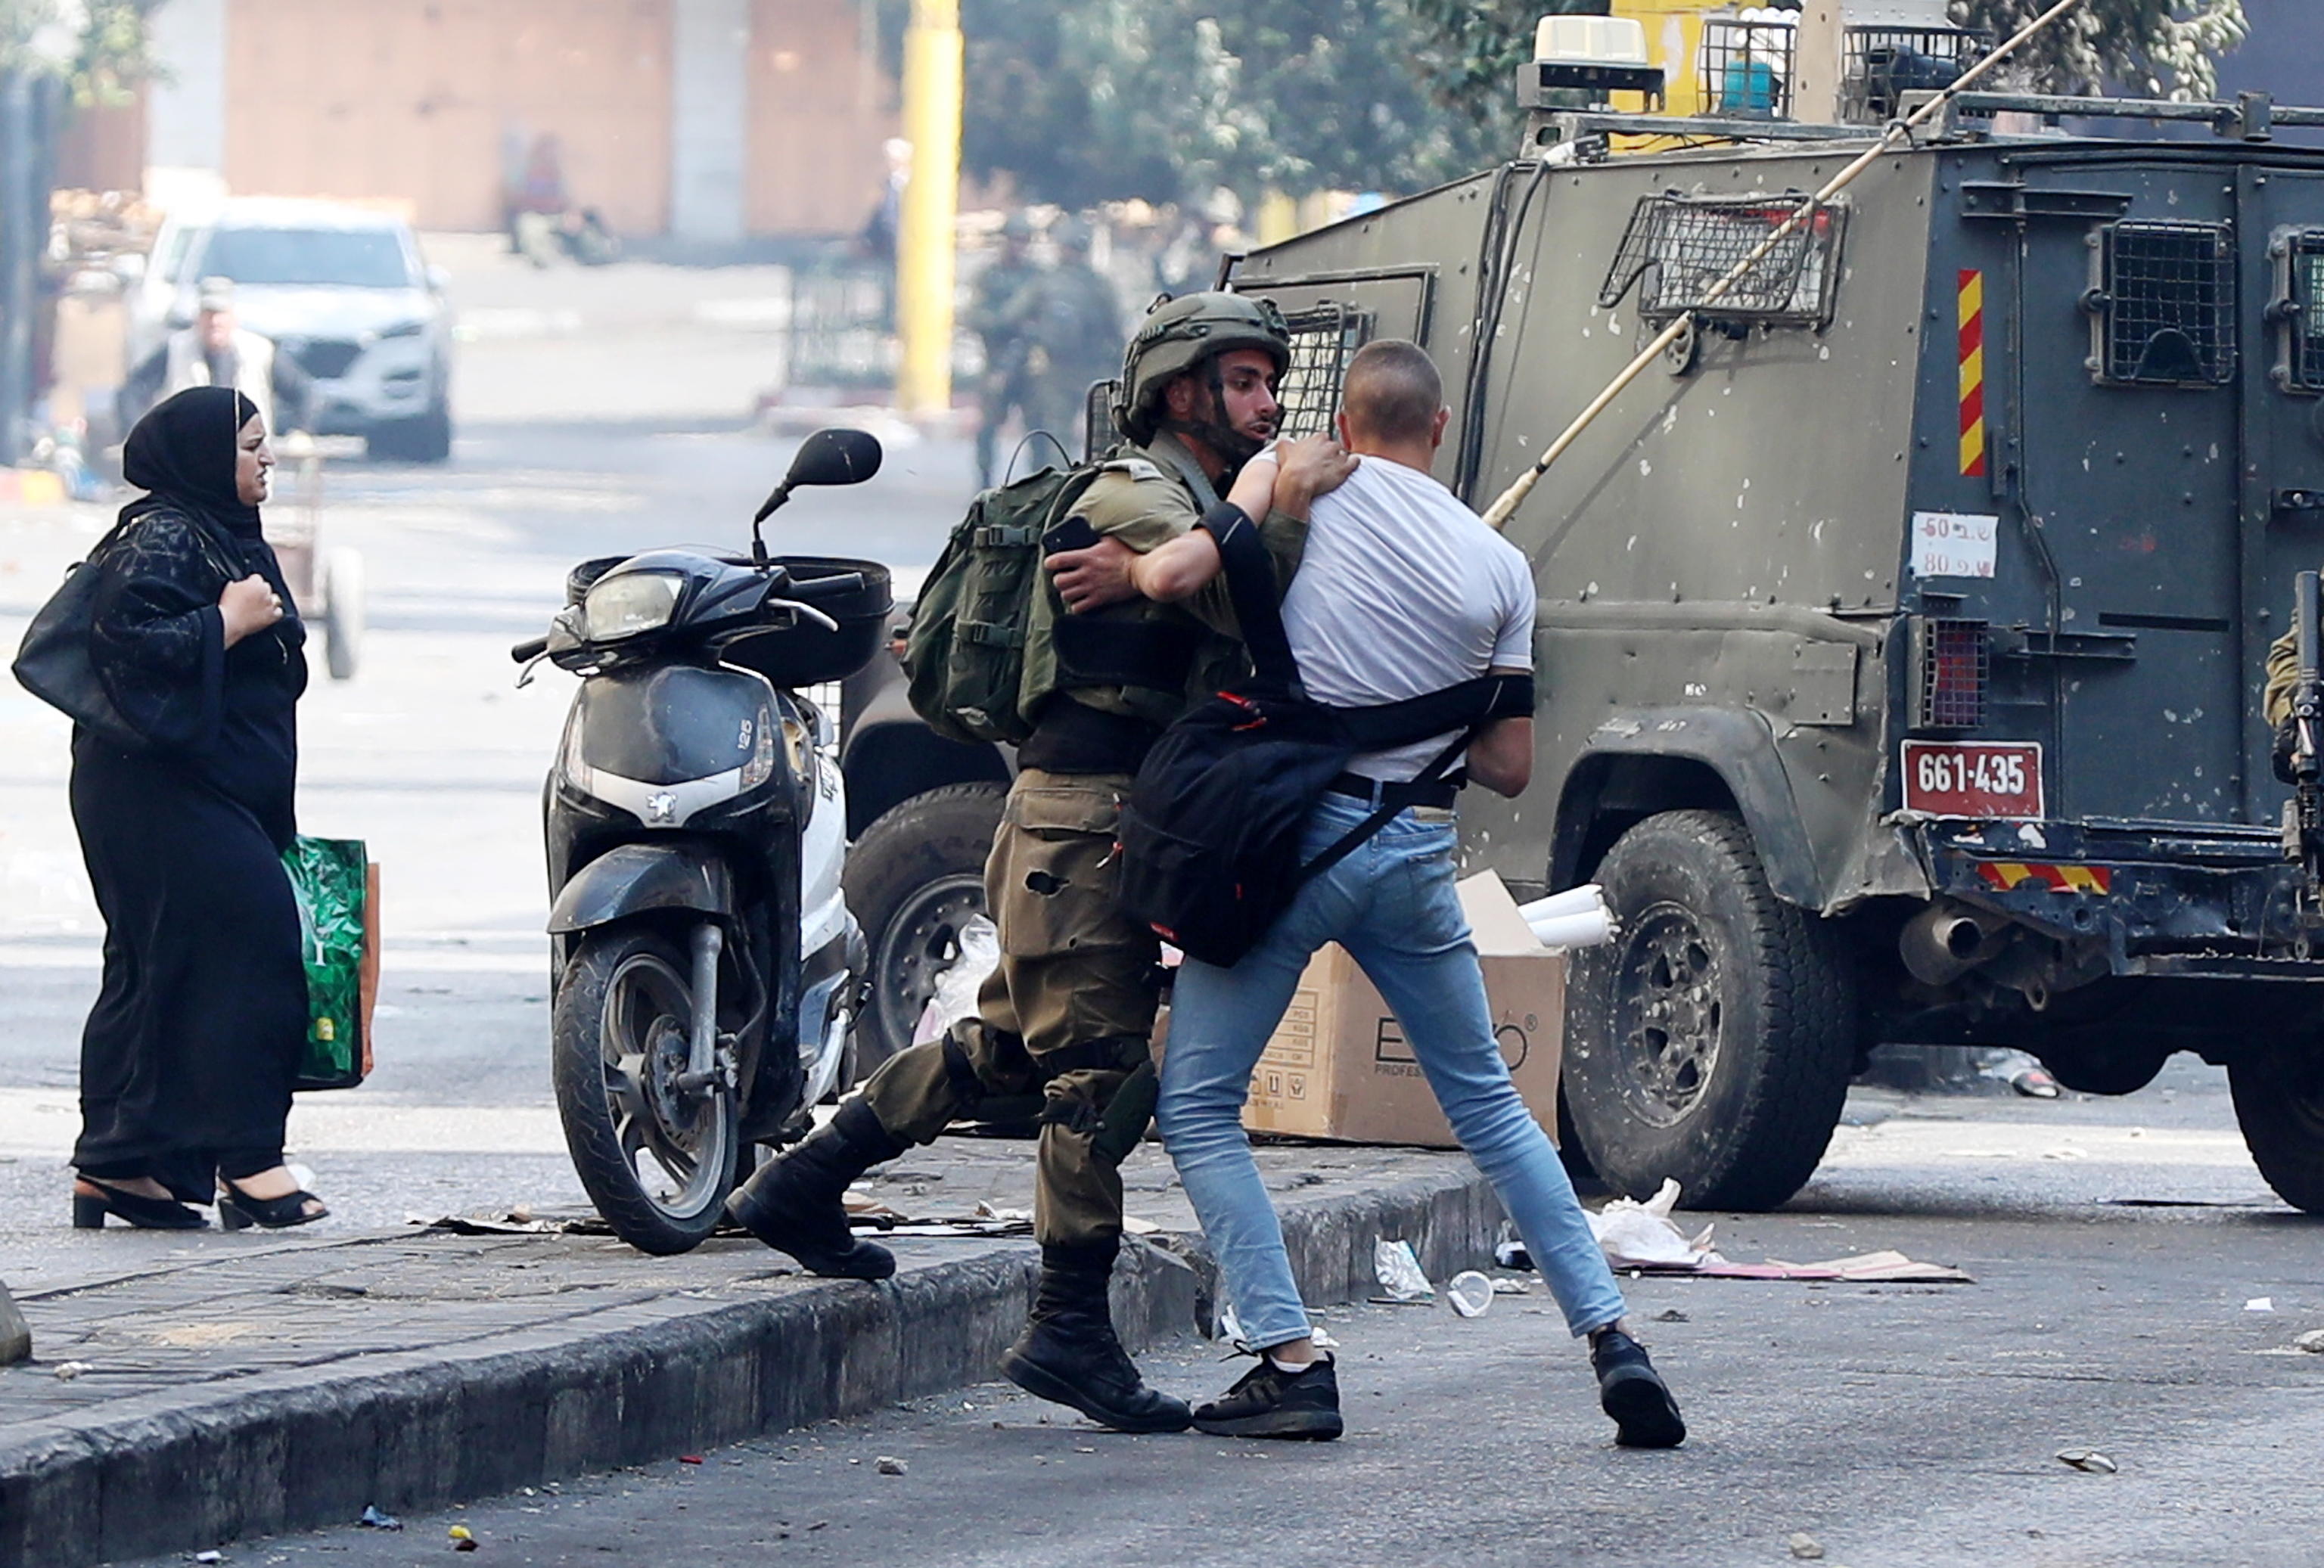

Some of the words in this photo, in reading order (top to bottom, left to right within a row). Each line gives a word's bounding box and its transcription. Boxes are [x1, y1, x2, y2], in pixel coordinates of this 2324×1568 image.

[1925, 553, 1949, 573] 80
[1918, 753, 2026, 794] 661-435
[1374, 1063, 1422, 1078] PROFES
